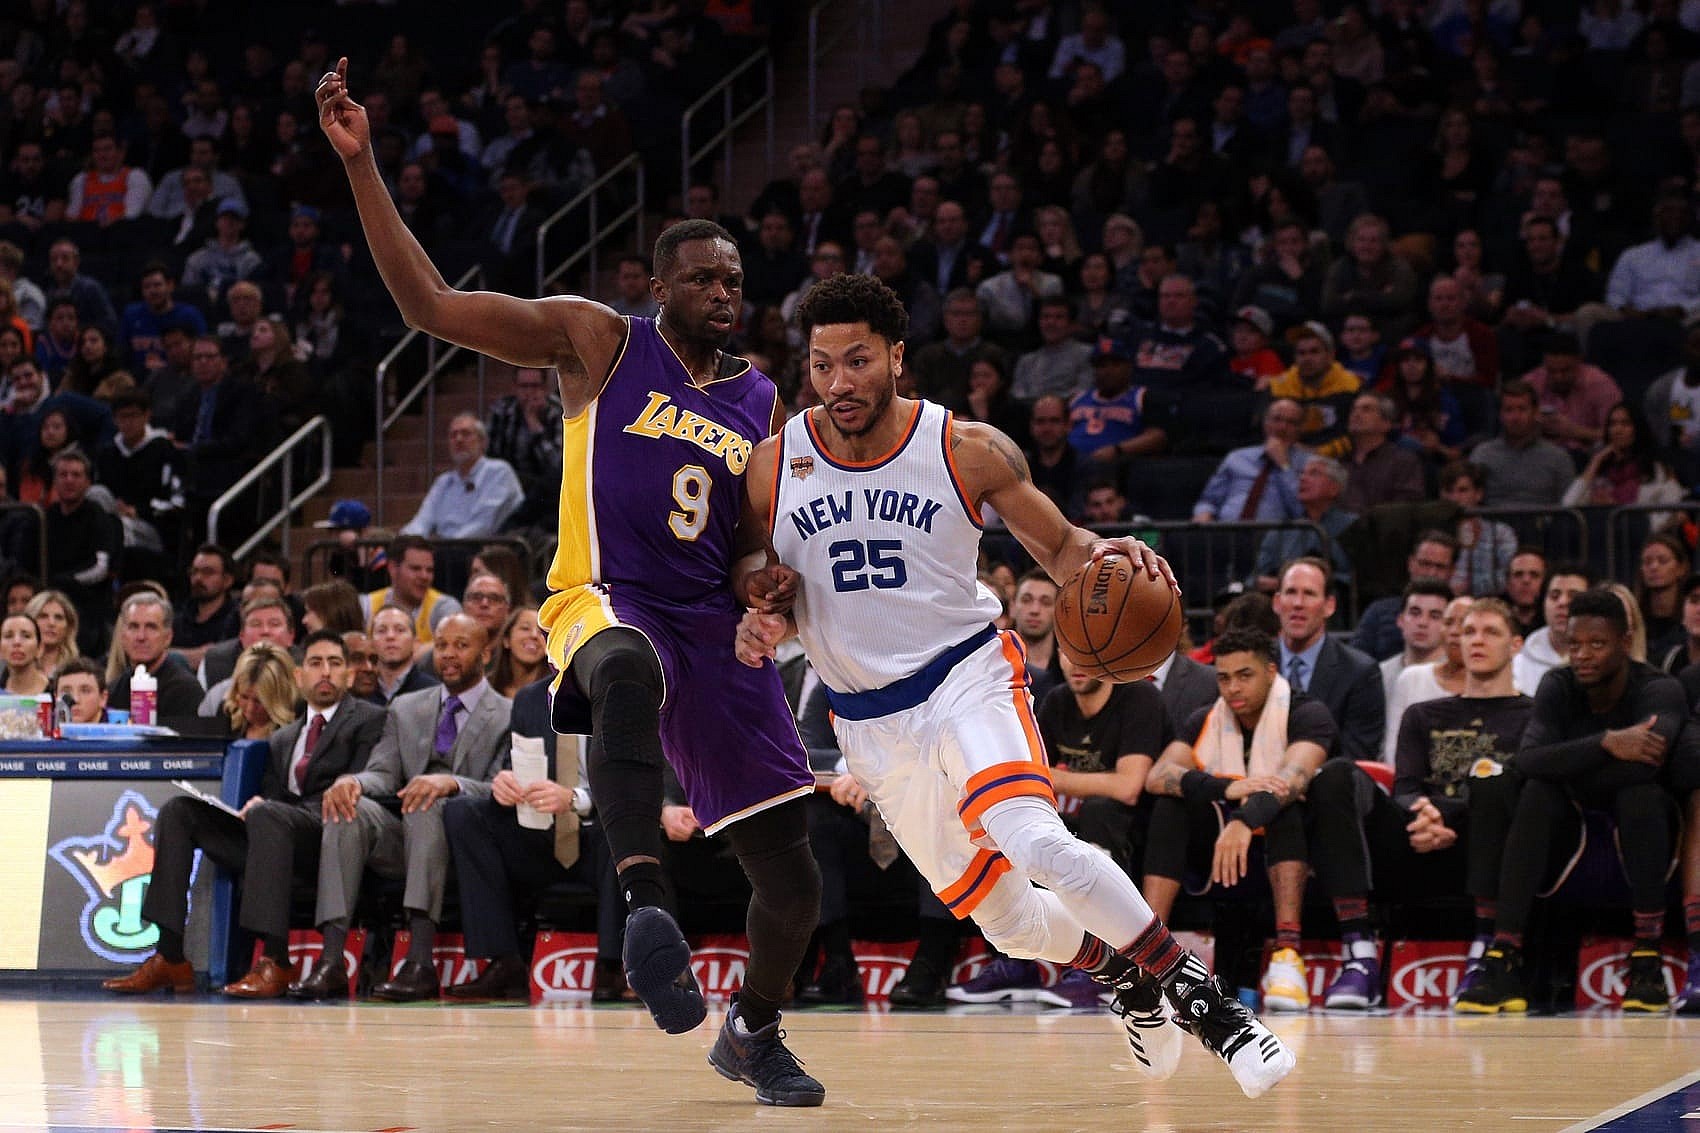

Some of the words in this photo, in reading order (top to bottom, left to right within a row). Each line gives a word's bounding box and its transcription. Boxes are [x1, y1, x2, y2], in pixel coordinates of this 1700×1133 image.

[623, 391, 752, 475] LAKERS
[668, 464, 713, 541] 9
[790, 490, 853, 541] NEW
[864, 489, 943, 534] YORK
[828, 539, 908, 592] 25
[1087, 559, 1118, 615] ALDING
[0, 760, 24, 771] HASE
[36, 760, 66, 771] CHASE
[79, 760, 109, 771] CHASE
[120, 760, 151, 771] CHASE
[163, 759, 193, 770] CHASE
[433, 959, 479, 987] IA
[551, 959, 596, 988] KI
[858, 966, 906, 995] IA
[1414, 967, 1459, 997] KI
